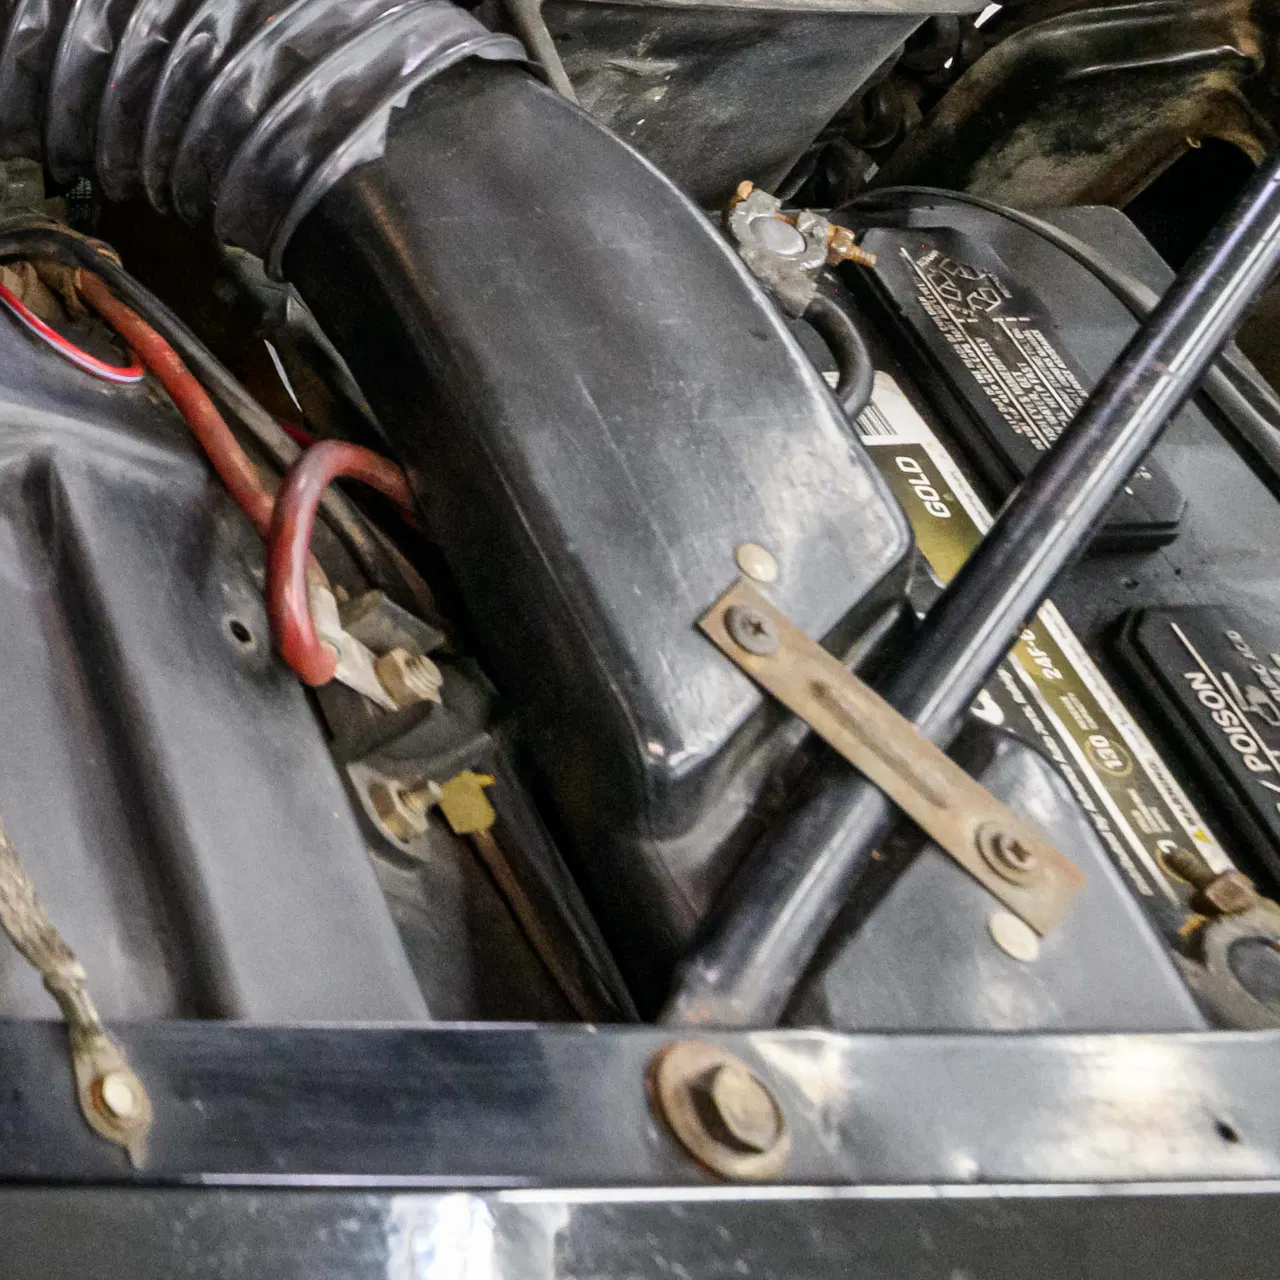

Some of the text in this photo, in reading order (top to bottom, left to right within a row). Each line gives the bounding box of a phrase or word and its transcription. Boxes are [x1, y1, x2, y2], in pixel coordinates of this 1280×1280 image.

[894, 455, 952, 520] GOLD
[1090, 733, 1123, 771] 130
[1183, 671, 1272, 772] POISON
